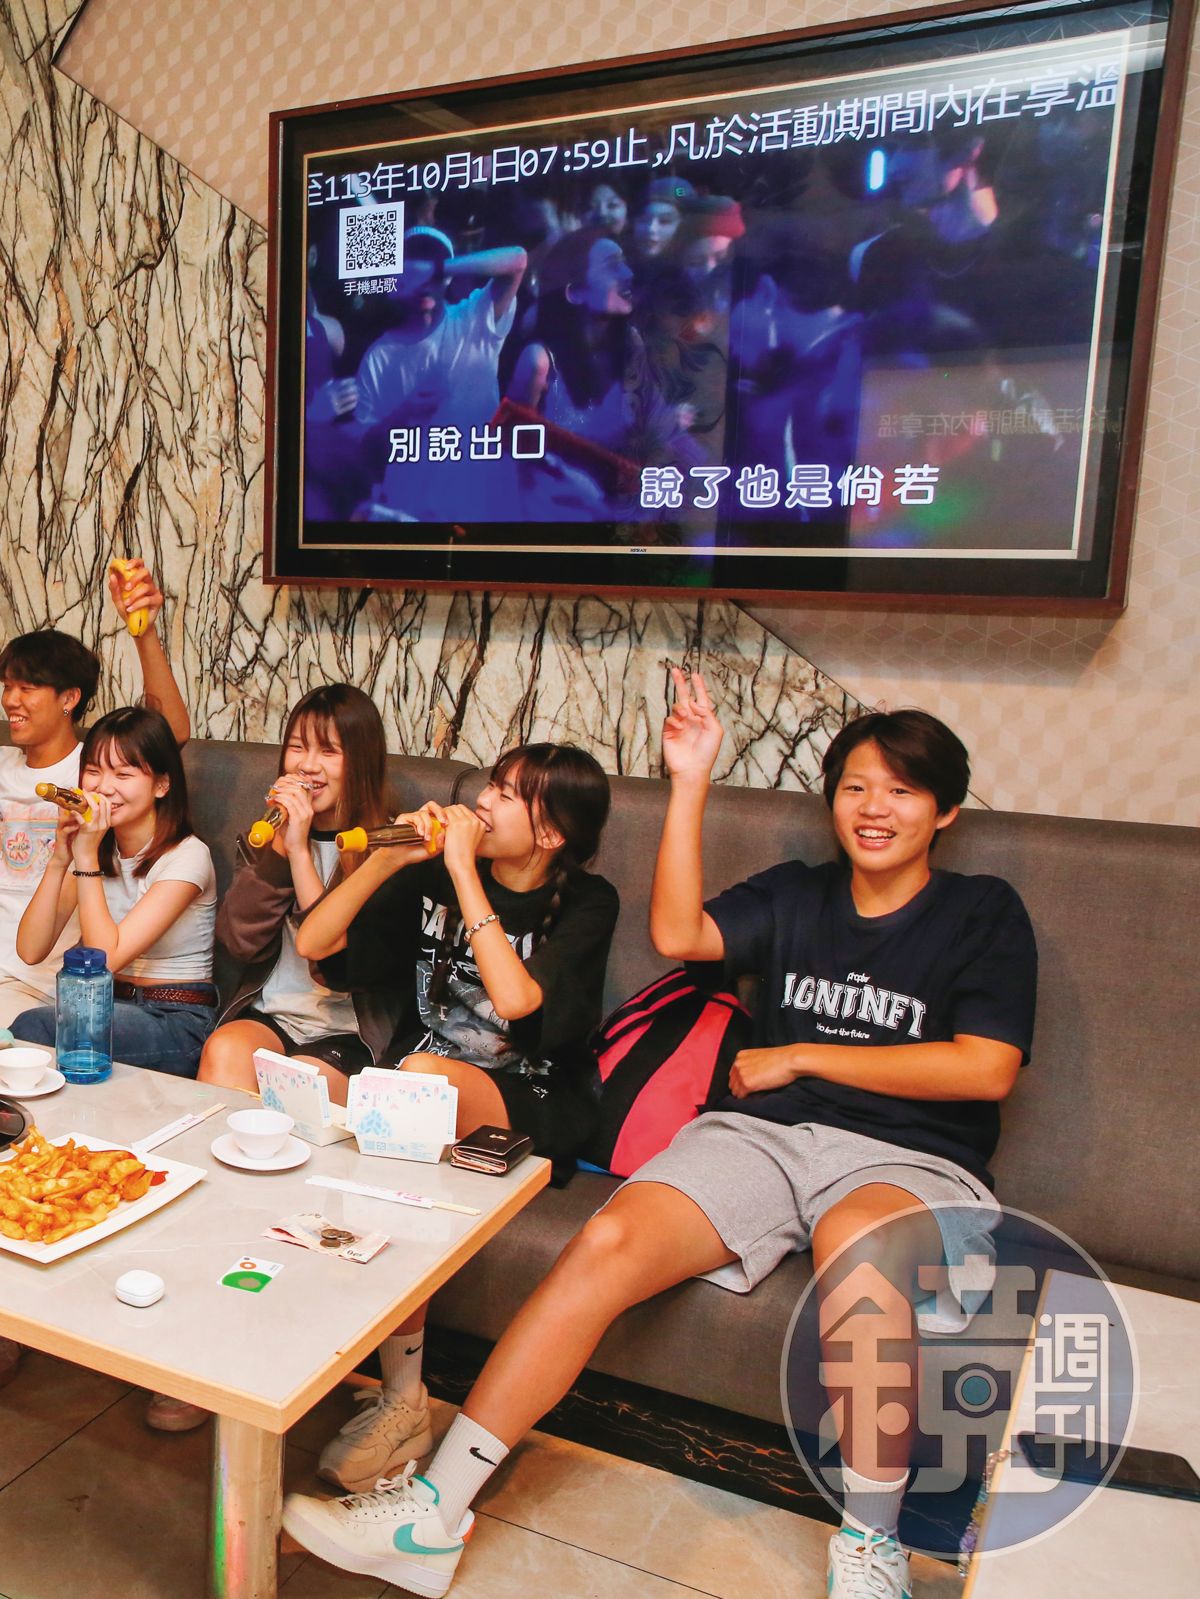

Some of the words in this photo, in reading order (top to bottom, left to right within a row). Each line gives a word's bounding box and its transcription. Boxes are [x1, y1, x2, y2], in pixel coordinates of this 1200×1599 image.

[343, 276, 398, 296] 手機點歌
[388, 424, 546, 463] 別說出口
[640, 462, 940, 508] 說了也是倘若
